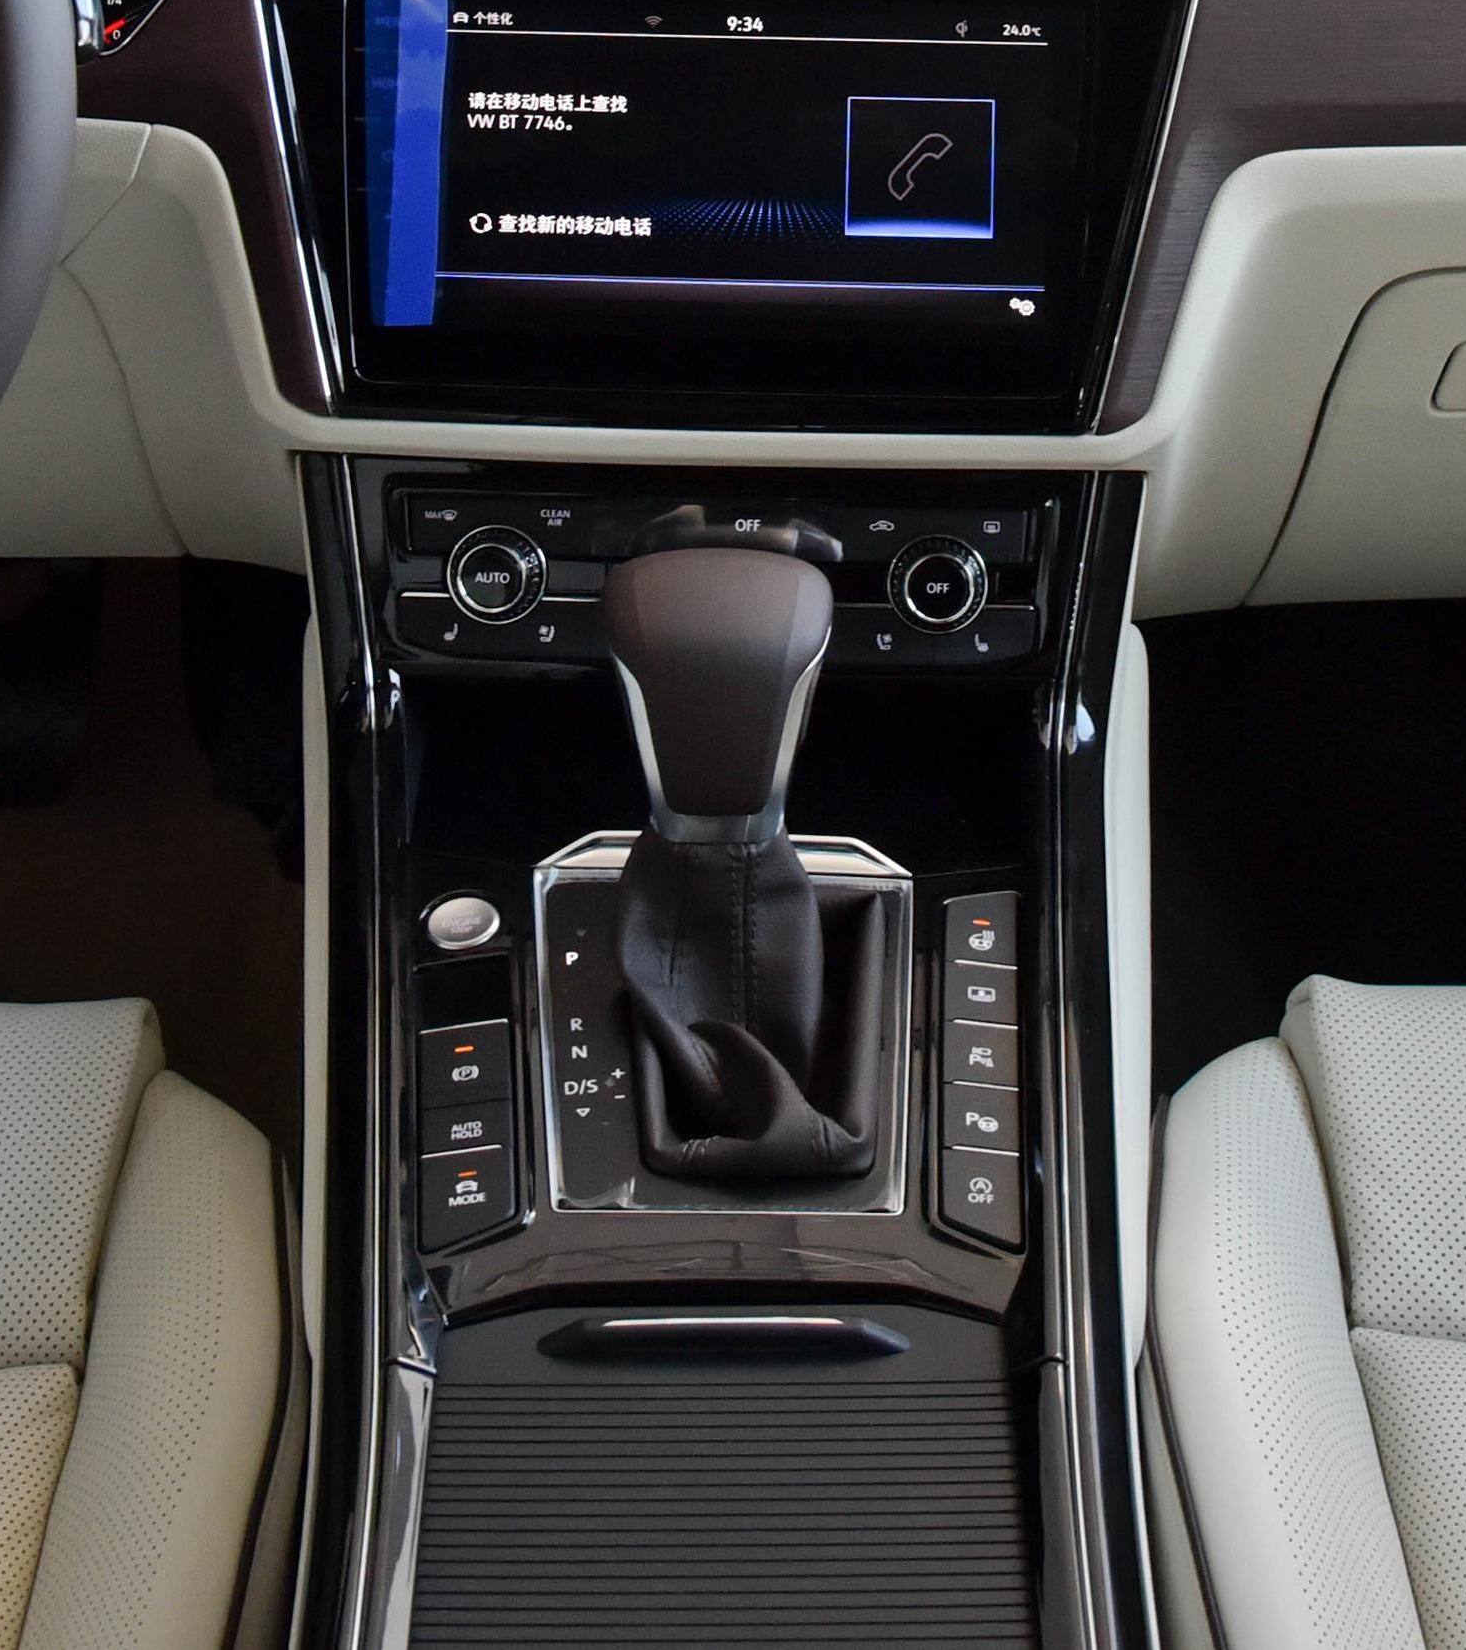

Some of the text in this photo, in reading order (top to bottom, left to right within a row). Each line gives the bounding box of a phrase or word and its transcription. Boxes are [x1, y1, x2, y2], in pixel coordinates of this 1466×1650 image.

[473, 12, 514, 26] 个性化
[726, 16, 764, 33] 9:34
[468, 92, 628, 114] 请在移动电话上查找
[467, 114, 495, 129] VW
[499, 114, 519, 130] BT
[498, 214, 652, 237] 查找新的移动电话
[424, 510, 443, 520] MAX
[540, 509, 571, 519] CLEAN
[547, 518, 563, 527] AIR
[734, 519, 761, 533] OFF
[475, 572, 510, 584] AUTO
[926, 582, 950, 595] OFF
[565, 951, 579, 966] P
[570, 1018, 583, 1031] R
[571, 1045, 588, 1059] N
[564, 1078, 598, 1095] D/S
[451, 1120, 482, 1132] AUTO
[451, 1128, 483, 1140] HOLD
[448, 1193, 486, 1207] MODE
[967, 1193, 995, 1204] OFF
